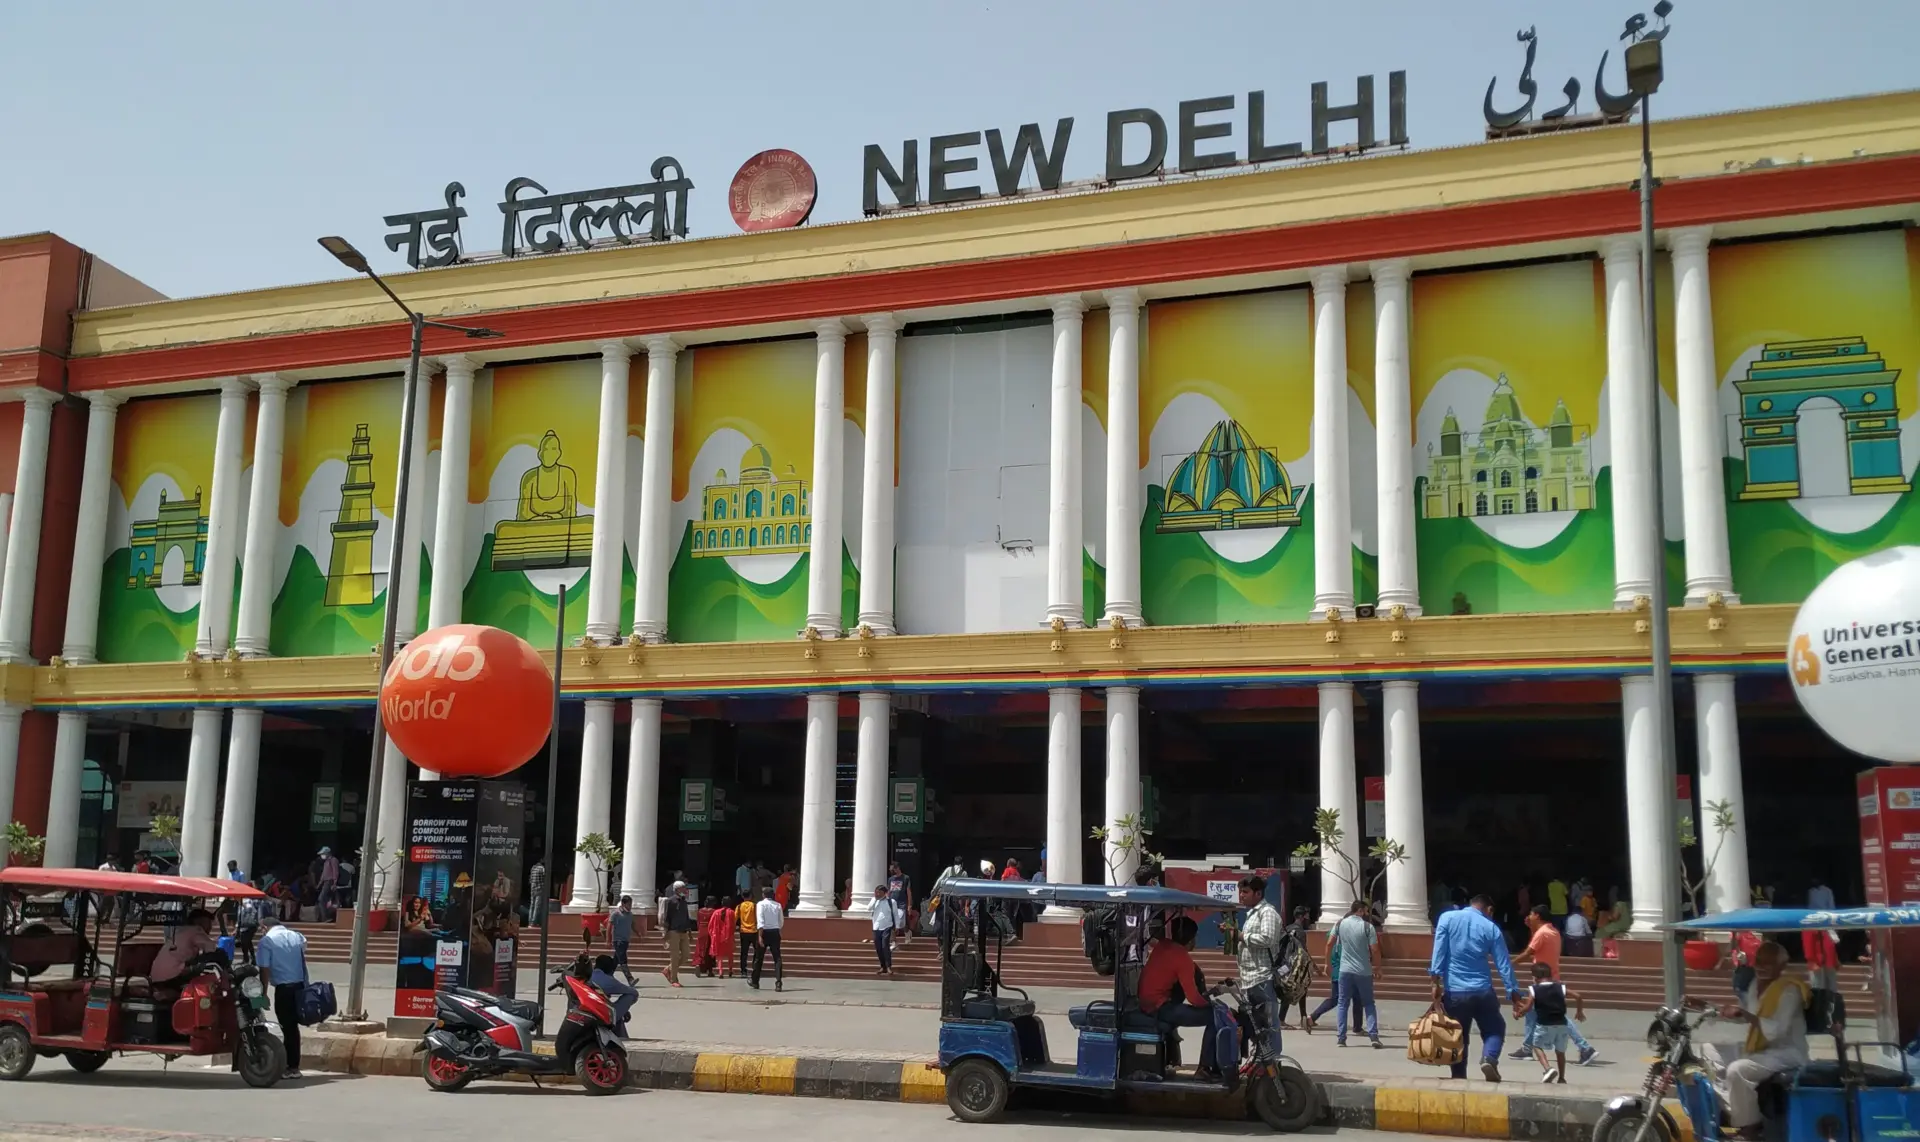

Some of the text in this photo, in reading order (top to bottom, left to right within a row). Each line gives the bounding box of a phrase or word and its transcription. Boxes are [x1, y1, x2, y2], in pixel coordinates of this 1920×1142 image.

[863, 70, 1408, 213] NEW DELHI
[767, 154, 799, 167] INDIAN
[383, 156, 695, 270] नई दिल्ली
[1825, 639, 1915, 664] General
[385, 690, 456, 726] World
[682, 812, 707, 823] शिखर
[892, 813, 918, 824] शिखर
[440, 946, 458, 957] bob
[412, 995, 434, 1003] Borrow
